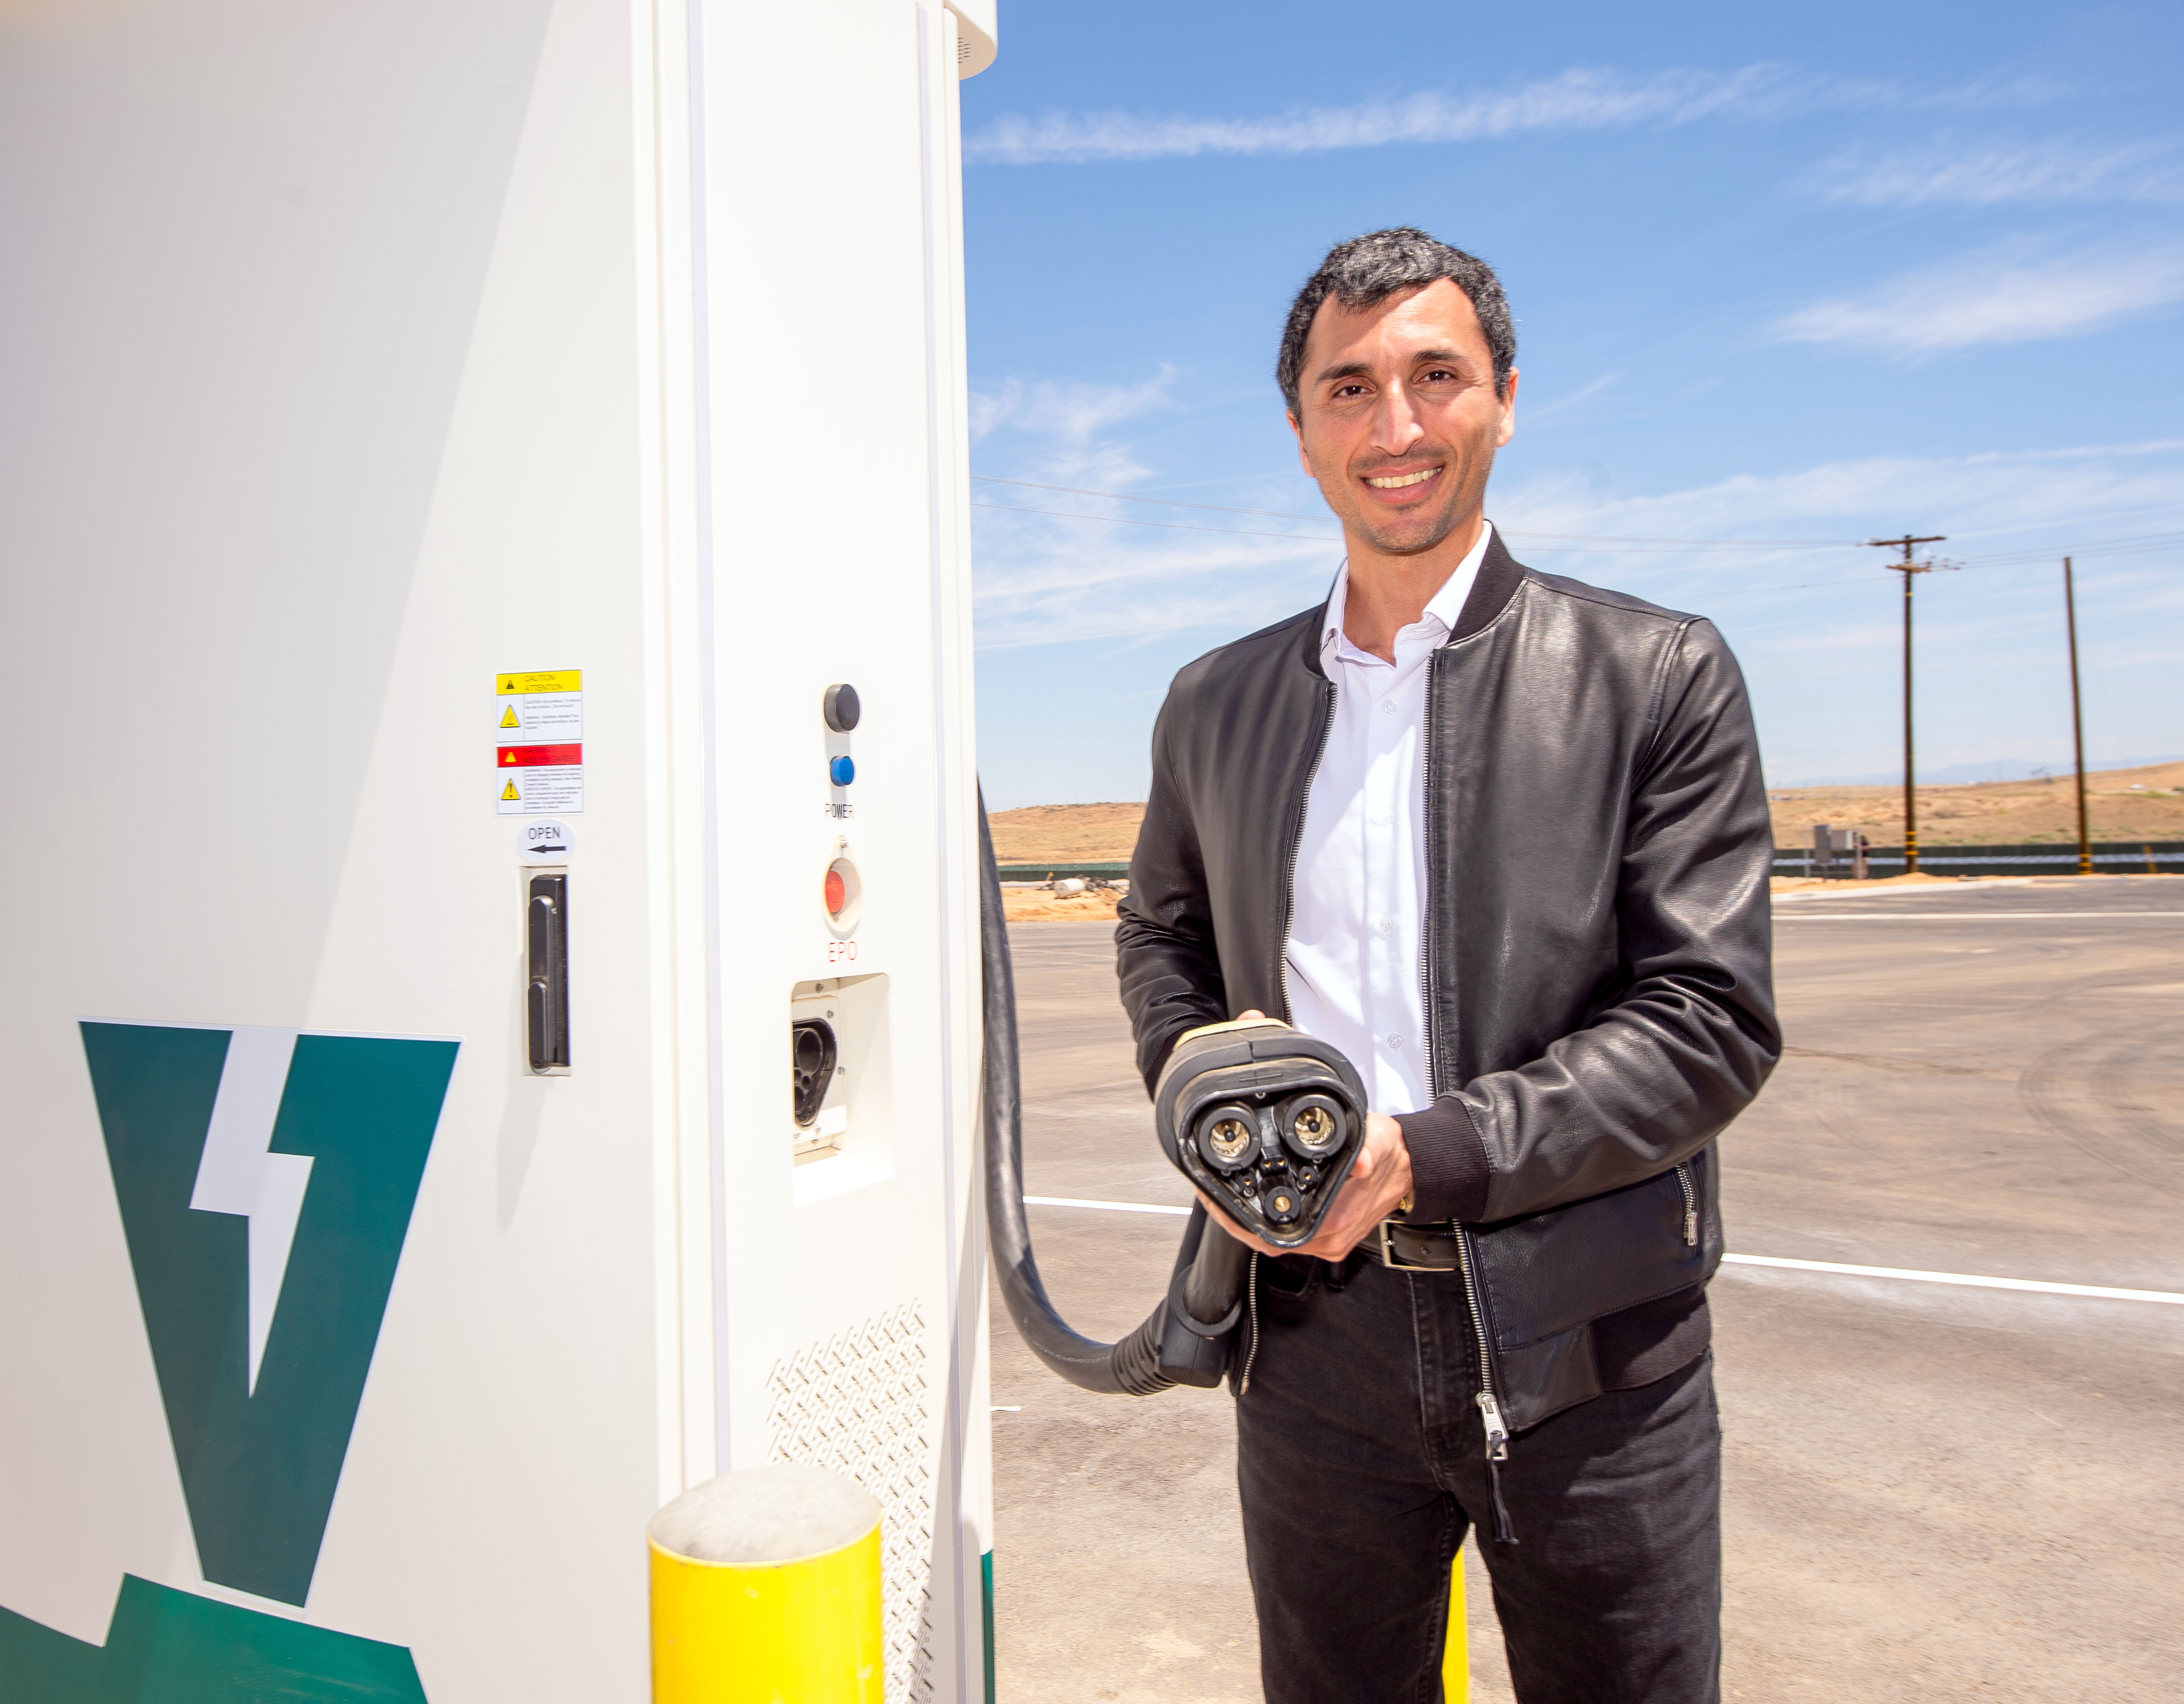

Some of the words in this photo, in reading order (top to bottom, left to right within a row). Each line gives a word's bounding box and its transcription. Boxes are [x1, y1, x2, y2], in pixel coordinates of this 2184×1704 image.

[825, 803, 854, 818] POWER
[528, 826, 561, 840] OPEN
[828, 941, 857, 962] EPO
